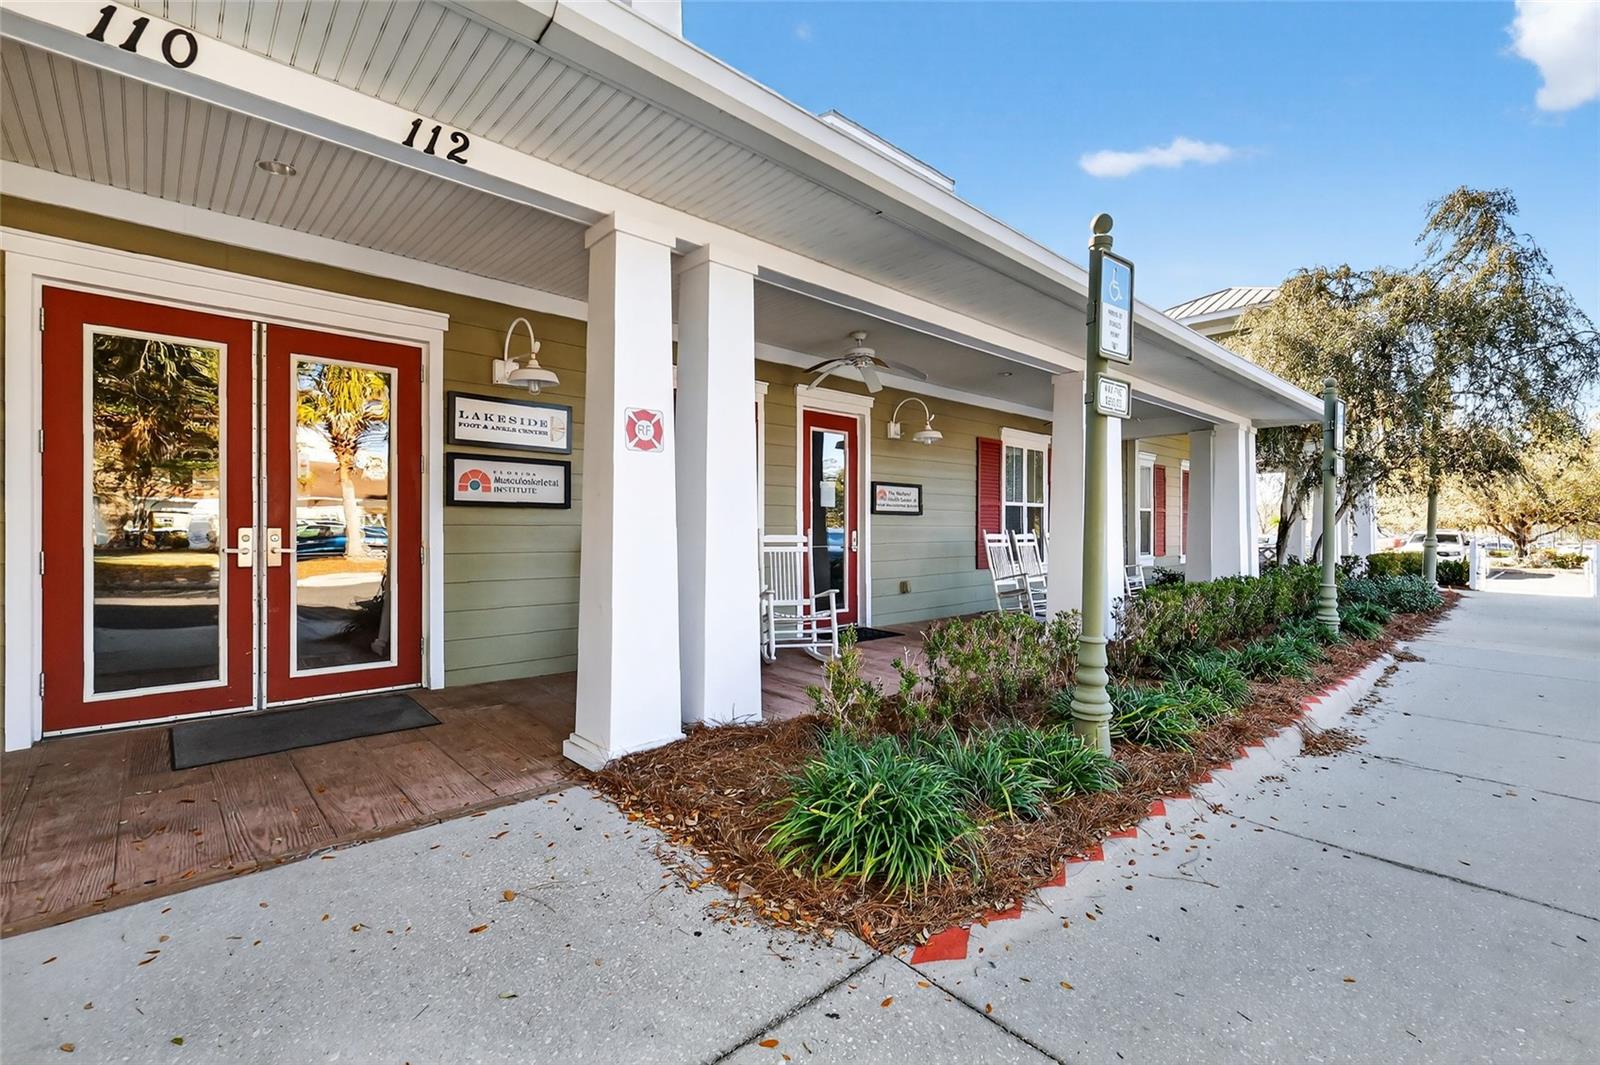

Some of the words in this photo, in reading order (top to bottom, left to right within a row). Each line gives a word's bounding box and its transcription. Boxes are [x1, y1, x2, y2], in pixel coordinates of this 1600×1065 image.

[86, 4, 198, 69] 110
[402, 118, 470, 165] 112
[458, 410, 548, 428] LAKESIDE
[458, 421, 481, 429] FOOT
[490, 424, 517, 433] ANKLE
[518, 427, 549, 436] CENTER
[637, 424, 651, 436] RF
[493, 476, 560, 487] Musculoskeletal
[493, 486, 538, 495] INSTITUTE
